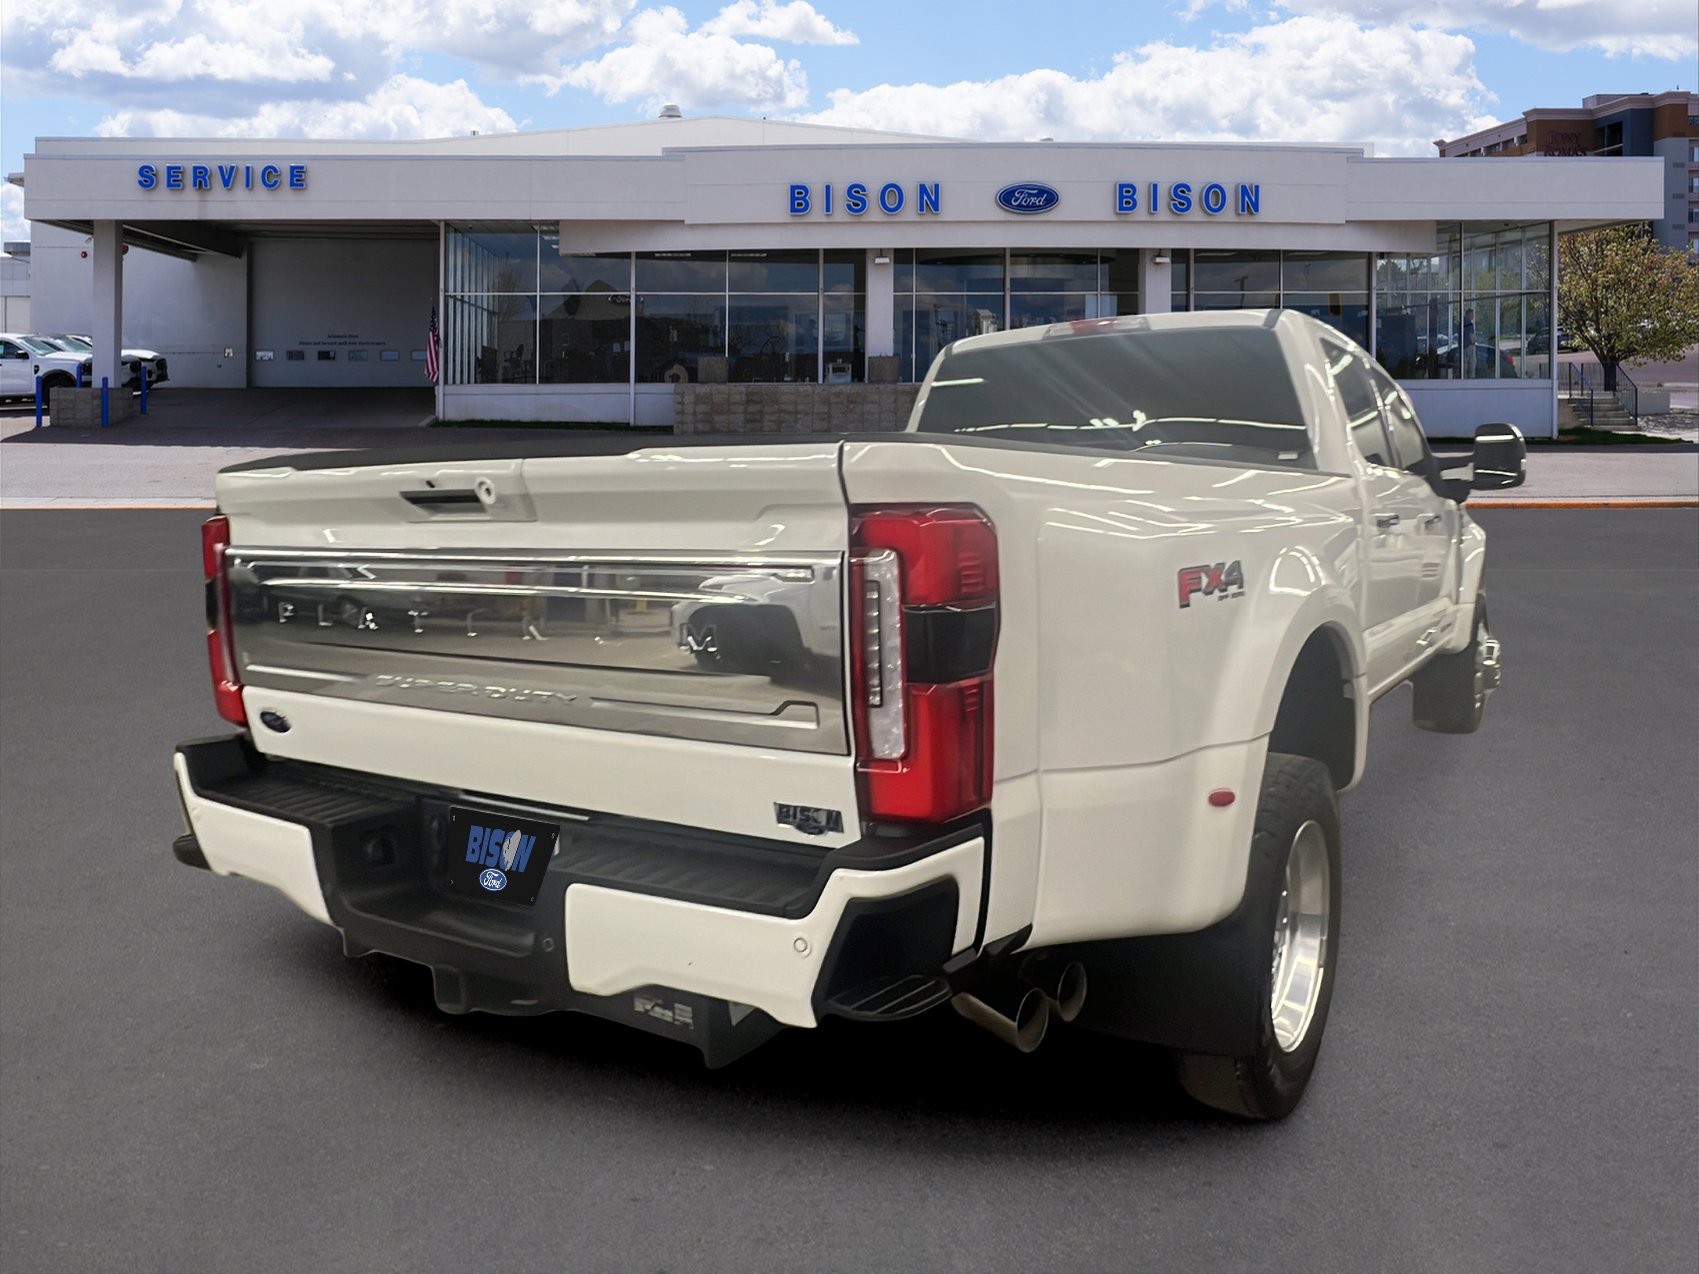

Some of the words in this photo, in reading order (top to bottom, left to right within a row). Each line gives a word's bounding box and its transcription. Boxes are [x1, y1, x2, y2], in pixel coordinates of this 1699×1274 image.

[137, 163, 306, 190] SERVICE
[788, 182, 942, 215] BISON
[1010, 188, 1048, 207] Ford
[1115, 182, 1260, 215] BISON
[1177, 560, 1244, 609] FX4
[483, 870, 503, 889] Ford
